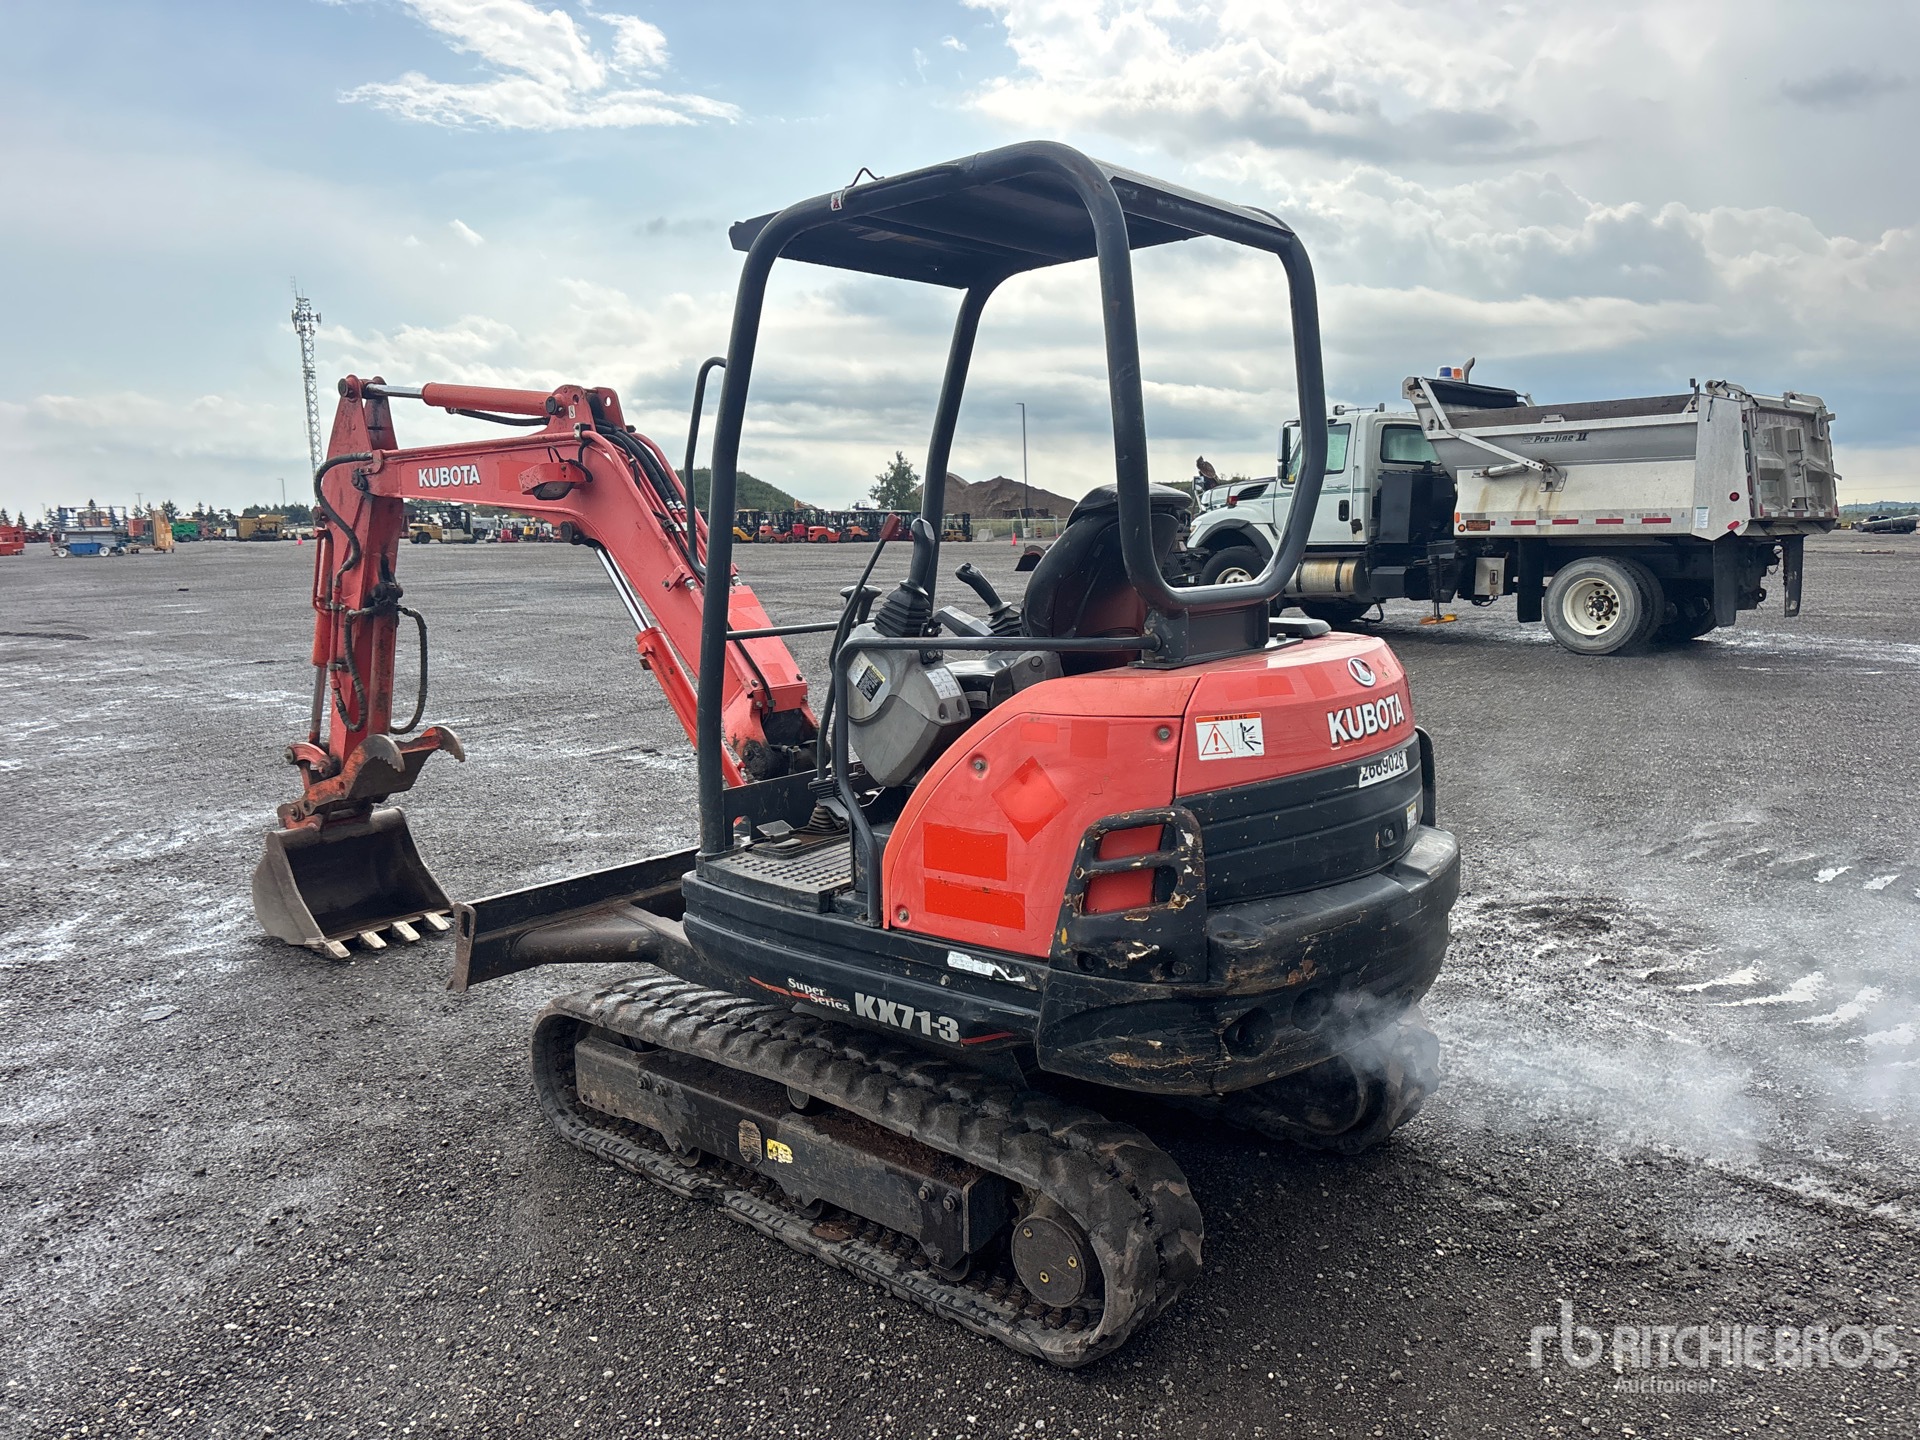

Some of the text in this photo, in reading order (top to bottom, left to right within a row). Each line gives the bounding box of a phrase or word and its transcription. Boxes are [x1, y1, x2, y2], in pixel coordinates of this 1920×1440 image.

[1534, 433, 1573, 443] Pro-line
[1575, 431, 1590, 442] II
[418, 464, 481, 488] KUBOTA
[1214, 713, 1248, 721] WARNING
[1327, 692, 1405, 744] KUBOTA
[788, 977, 825, 997] Super
[810, 993, 850, 1012] Series
[854, 991, 960, 1043] KX71-3
